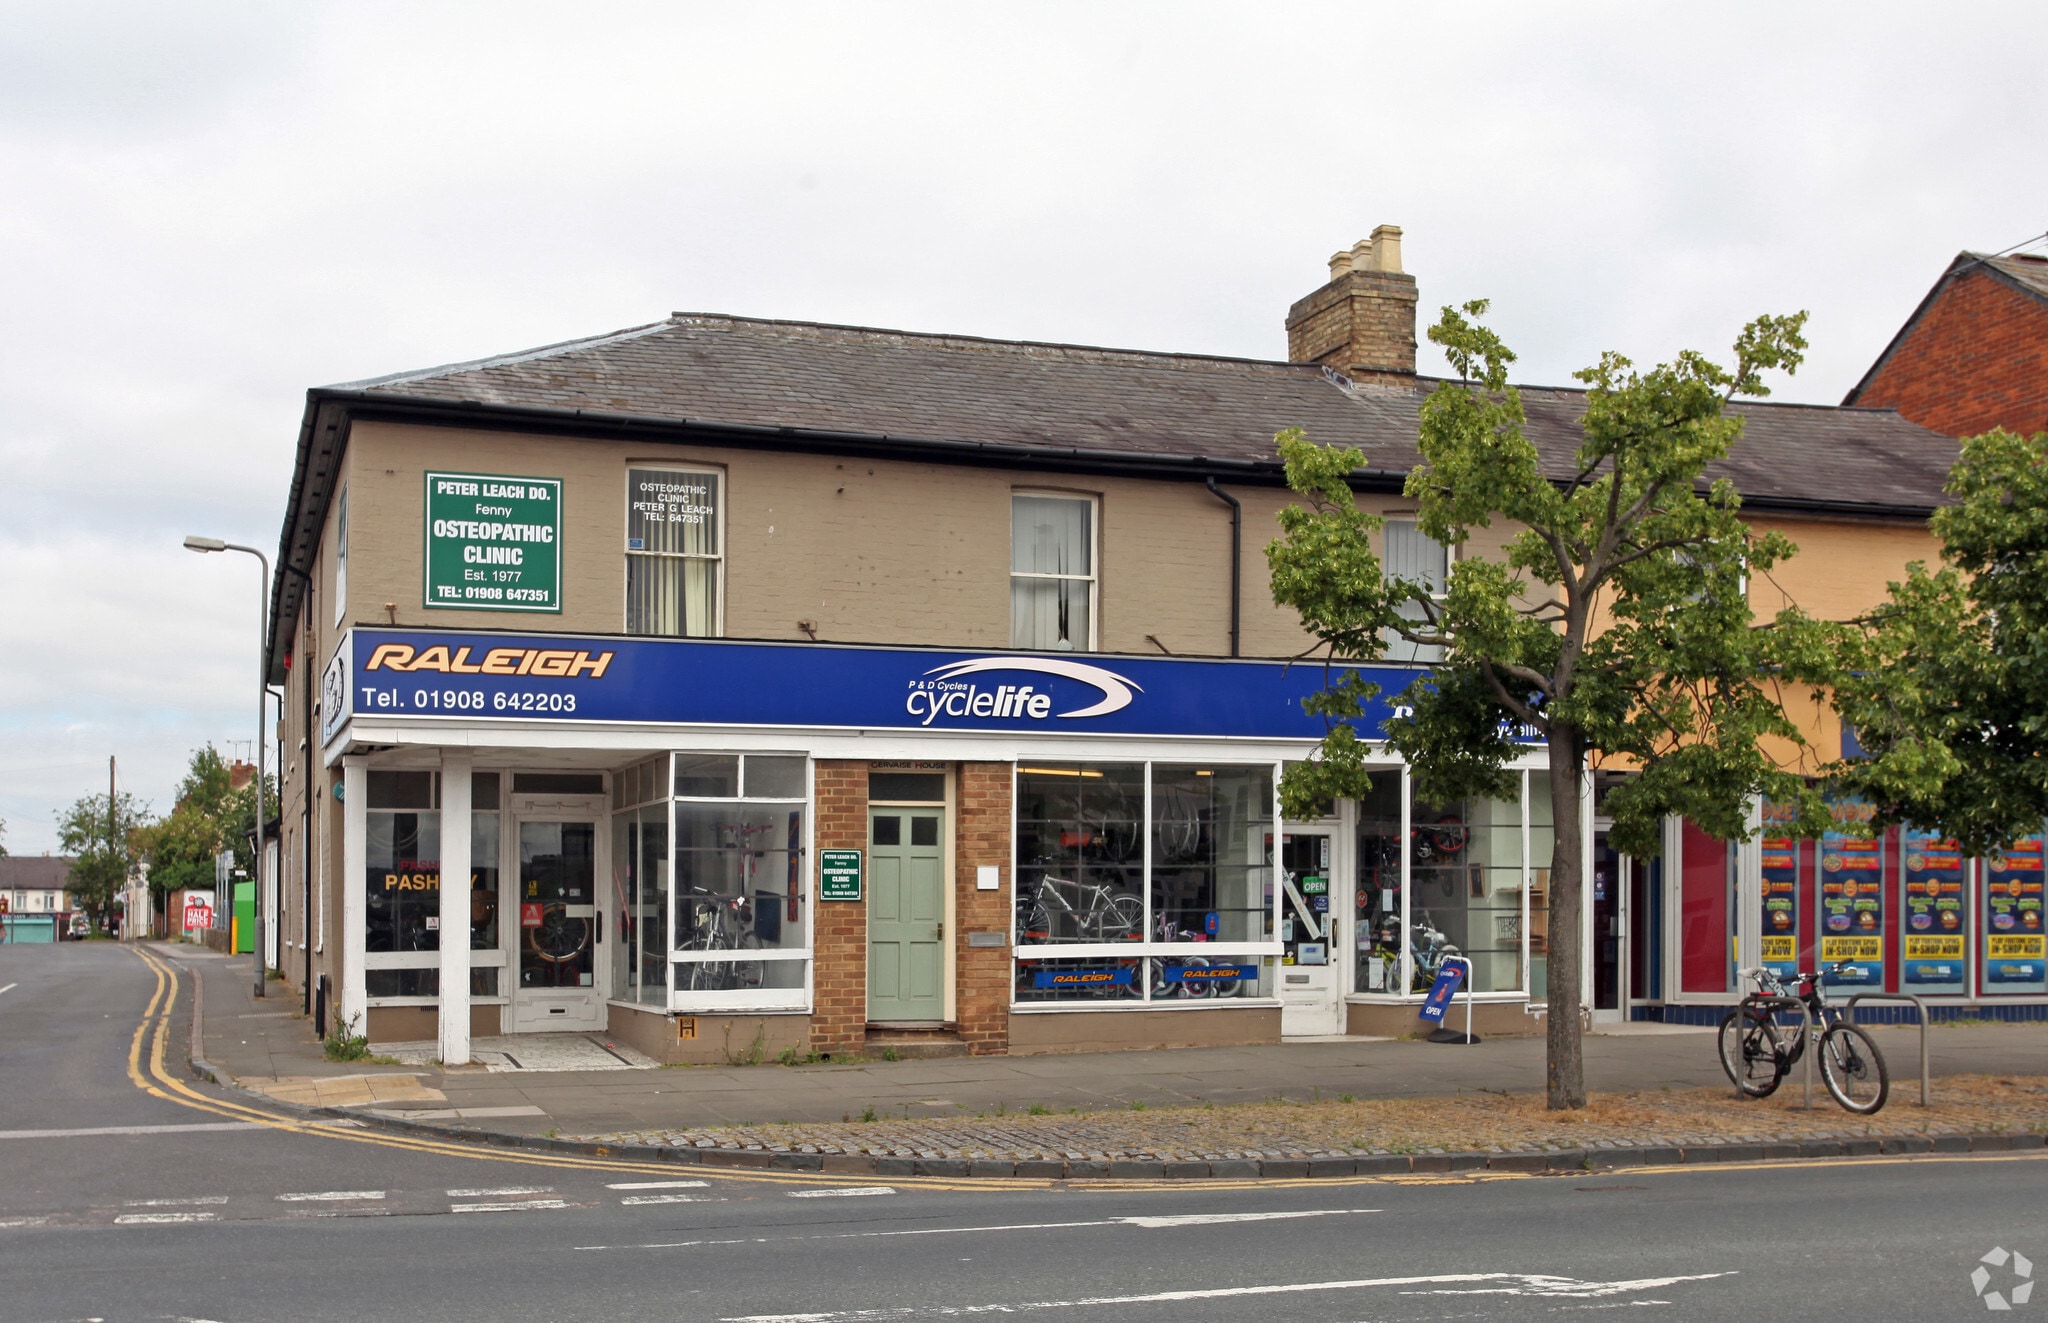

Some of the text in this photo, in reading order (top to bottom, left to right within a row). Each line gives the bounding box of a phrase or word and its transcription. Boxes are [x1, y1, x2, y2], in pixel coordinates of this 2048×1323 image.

[438, 482, 551, 500] PETER LEACH DO.
[640, 483, 707, 495] OSTEOPATHIC
[658, 494, 689, 504] CLINIC
[476, 504, 512, 518] Fenny
[634, 502, 713, 515] PETER G LEACH
[644, 512, 704, 524] TEL: 647351
[434, 520, 553, 543] OSTEOPATHIC
[464, 546, 523, 566] CLINIC
[464, 569, 522, 583] Est. 1977
[438, 585, 549, 602] TEL: 01908 647351
[365, 644, 614, 678] RALEIGH
[927, 681, 935, 689] D
[937, 682, 968, 691] Cycles
[362, 688, 576, 712] Tel. 01908 642203
[906, 685, 1050, 726] cyclelife
[1304, 882, 1326, 891] OPEN
[1772, 946, 1791, 955] NOW
[1826, 946, 1878, 956] IN-SHOP NOW
[1909, 945, 1959, 954] IN-SHOP NOW
[1991, 945, 2041, 954] IN-SHOP NOW
[1053, 973, 1113, 983] RALEIGH
[1182, 969, 1240, 978] RALEIGH
[1426, 1006, 1441, 1016] OPEN
